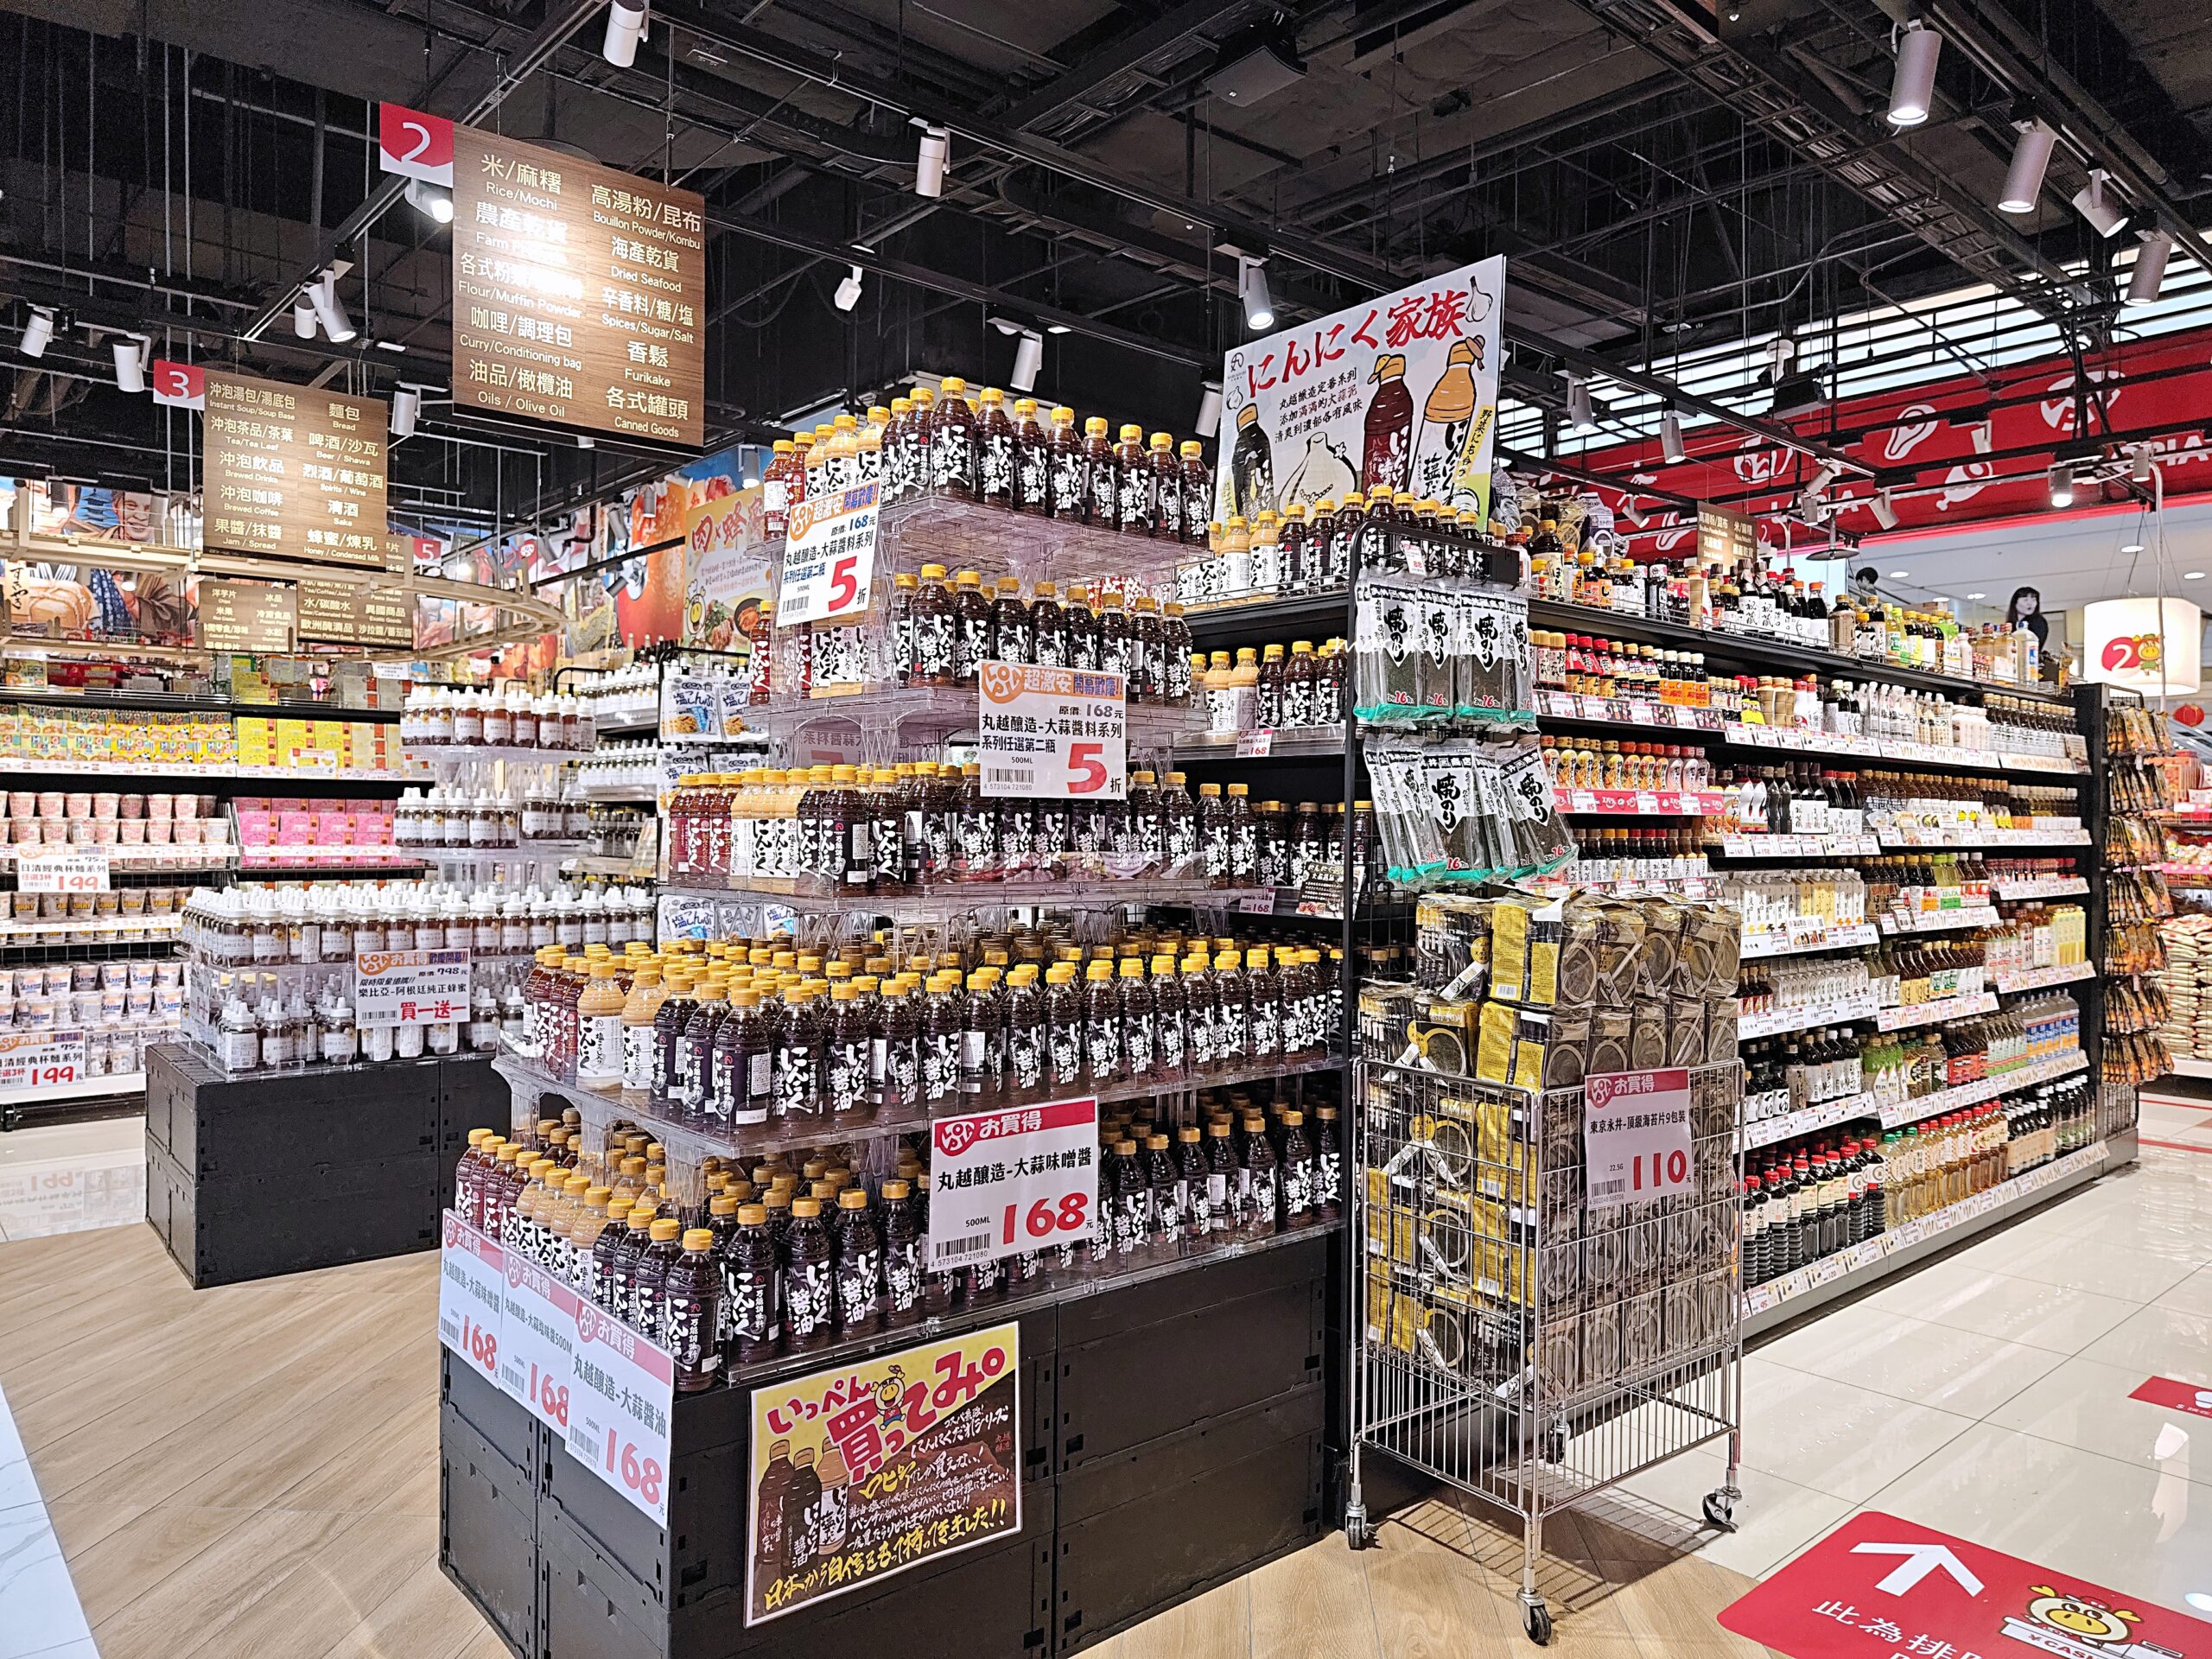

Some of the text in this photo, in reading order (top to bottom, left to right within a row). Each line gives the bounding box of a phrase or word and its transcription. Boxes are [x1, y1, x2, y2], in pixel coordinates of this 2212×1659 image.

[401, 122, 430, 162] 2
[481, 154, 562, 195] 米/麻糬
[486, 181, 557, 212] Rice/Mochi
[591, 184, 701, 233] 高湯粉/昆布
[476, 232, 508, 251] Farm
[594, 211, 701, 250] Bouillon Powder/Kombu
[611, 236, 678, 273] 海產乾貨
[611, 266, 682, 293] Dried Seafood
[459, 281, 582, 319] Flour/Muffin Powder
[601, 287, 694, 327] 辛香料/糖/塩
[470, 306, 572, 347] 咖哩/調理包
[601, 314, 694, 344] Spices/Sugar/Salt
[460, 334, 582, 371] Curry/Conditioning bag
[627, 340, 668, 369] 香鬆
[1248, 289, 1470, 399] にんにく家族
[169, 371, 189, 399] 3
[469, 359, 573, 400] 油品/橄欖油
[625, 369, 671, 387] Furikake
[210, 382, 296, 410] 沖泡湯包/湯底包
[478, 391, 564, 417] Oils Olive Oil
[605, 386, 689, 421] 各式罐頭
[210, 400, 296, 421] Instant Soup/Soup Base
[211, 416, 294, 443] 沖泡茶品/茶葉
[333, 422, 356, 431] Bread
[614, 416, 678, 438] Canned Goods
[226, 436, 279, 451] Tea/Tea Leaf
[308, 432, 378, 456] 啤酒/沙瓦
[219, 451, 284, 474] 沖泡飲品
[317, 450, 371, 466] Beer Shawa
[226, 469, 278, 484] Brewed Drinks
[220, 485, 283, 507] 沖泡咖啡
[320, 483, 366, 497] Spirits Wine
[224, 503, 279, 518] Brewed Coffee
[327, 499, 359, 518] 清酒
[334, 518, 353, 527] Sake
[849, 515, 868, 531] 168
[223, 537, 276, 551] Jam Spread
[304, 546, 324, 557] Honey
[331, 550, 365, 561] Condensed
[367, 554, 380, 563] Milk
[423, 543, 434, 560] 5
[828, 556, 857, 613] 5
[1024, 669, 1072, 693] 超激安
[1087, 704, 1113, 717] 168
[982, 735, 1056, 753] 系列任選第二瓶
[1249, 747, 1268, 756] 168
[1067, 743, 1122, 793] 5 折
[1432, 772, 1460, 829] 焼のり
[59, 876, 98, 890] 199
[1253, 904, 1269, 912] 168
[400, 1000, 467, 1021] 買一送一
[0, 1052, 83, 1067] 清經典杯麵系列
[32, 1066, 74, 1085] 199
[1615, 1074, 1655, 1094] お買得
[979, 1110, 1042, 1139] お買得
[1610, 1163, 1624, 1172] 22.5G
[1633, 1149, 1692, 1191] 110 元
[965, 1216, 990, 1228] 500ML
[1003, 1192, 1094, 1245] 168 元
[457, 1228, 481, 1257] お買得
[938, 1255, 963, 1267] 573104
[964, 1250, 988, 1262] 721080
[522, 1266, 551, 1300] お買得
[463, 1314, 497, 1371] 168
[597, 1319, 635, 1360] お買得
[530, 1363, 569, 1427] 168
[585, 1416, 601, 1434] 500ML
[606, 1427, 665, 1516] 168 元
